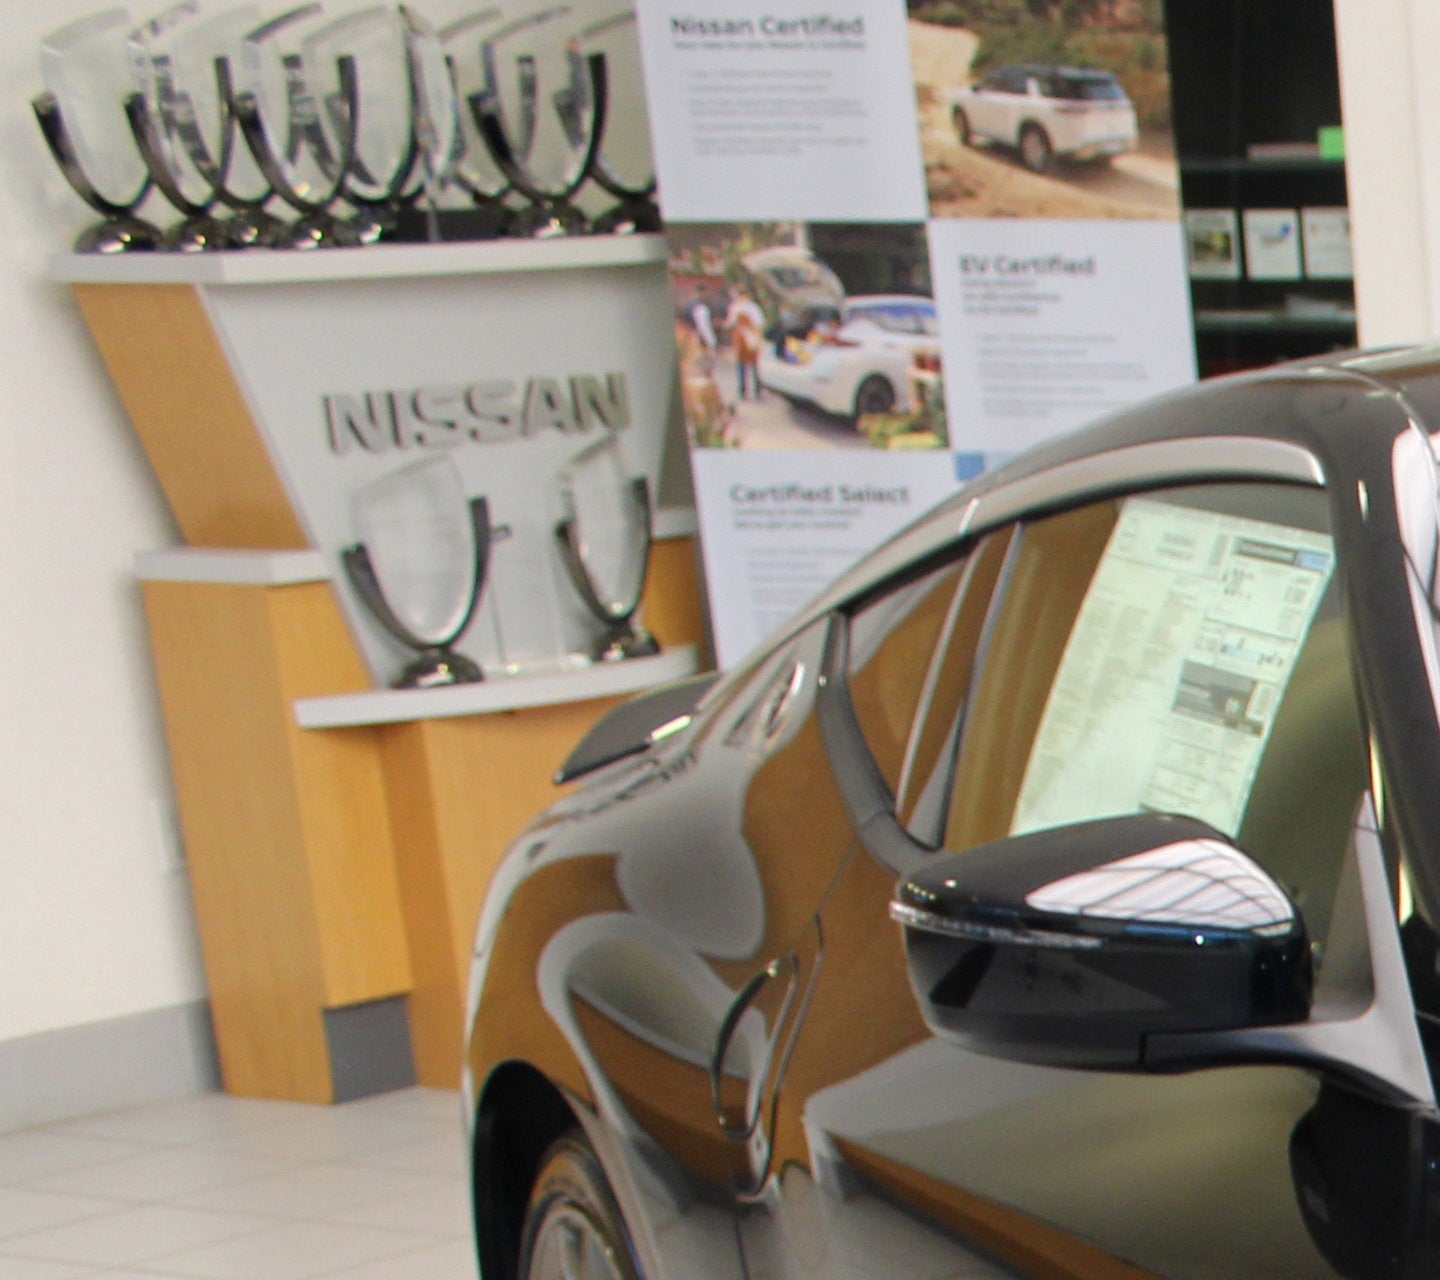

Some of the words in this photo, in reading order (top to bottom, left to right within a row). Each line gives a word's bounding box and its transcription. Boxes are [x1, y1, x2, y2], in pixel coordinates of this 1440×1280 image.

[671, 16, 754, 35] Nissan
[759, 14, 866, 35] Certified
[959, 254, 989, 274] EV
[993, 253, 1097, 276] Certified
[322, 373, 632, 455] NISSAN
[729, 484, 834, 503] Certified
[838, 484, 910, 504] Select
